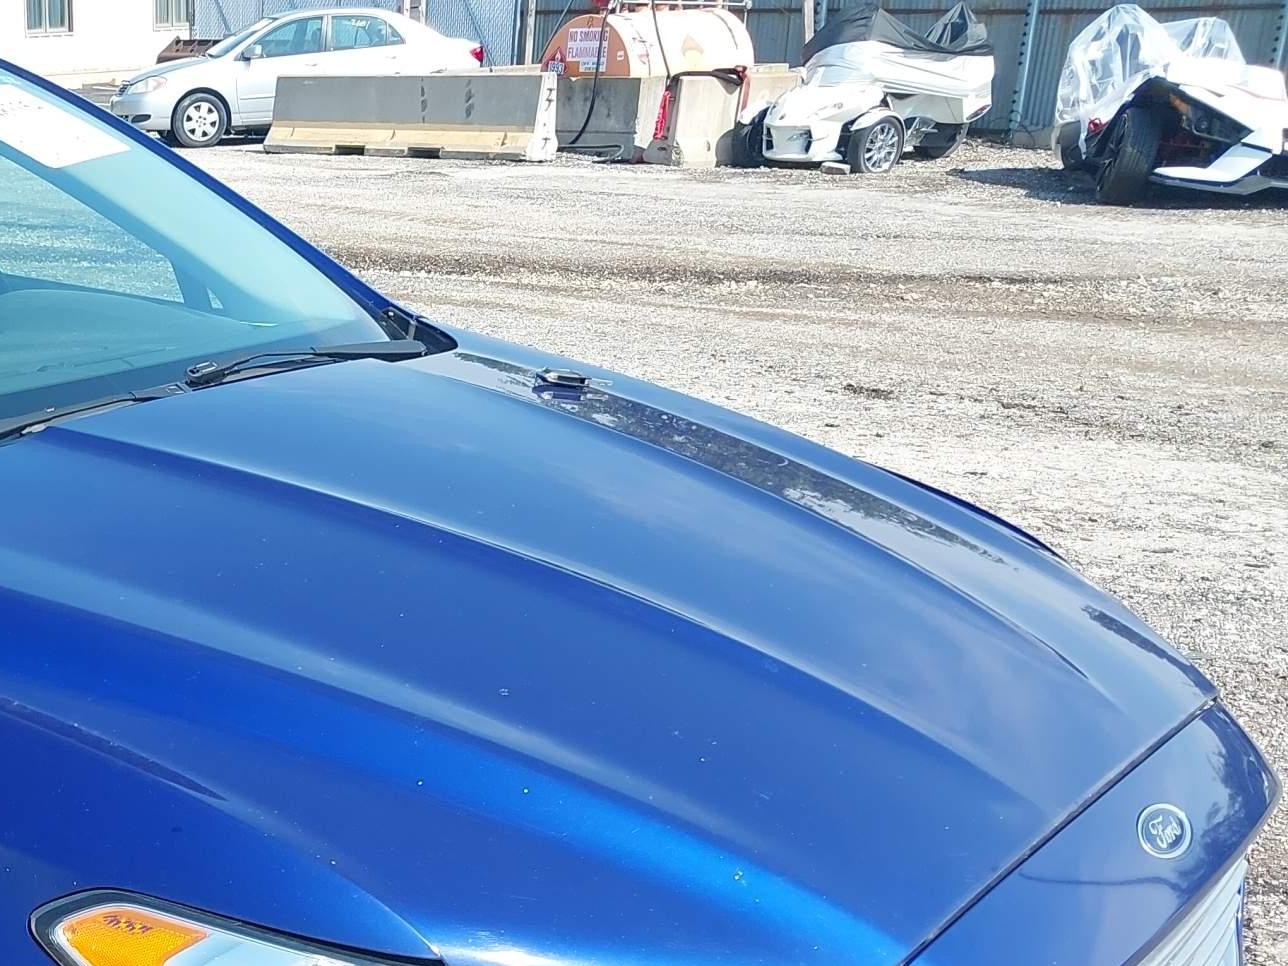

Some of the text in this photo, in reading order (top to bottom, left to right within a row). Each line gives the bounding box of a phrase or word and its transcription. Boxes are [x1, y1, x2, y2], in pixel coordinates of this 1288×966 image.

[569, 30, 608, 42] NO SMOKIG
[549, 61, 563, 73] 1993
[1148, 815, 1182, 849] Ford
